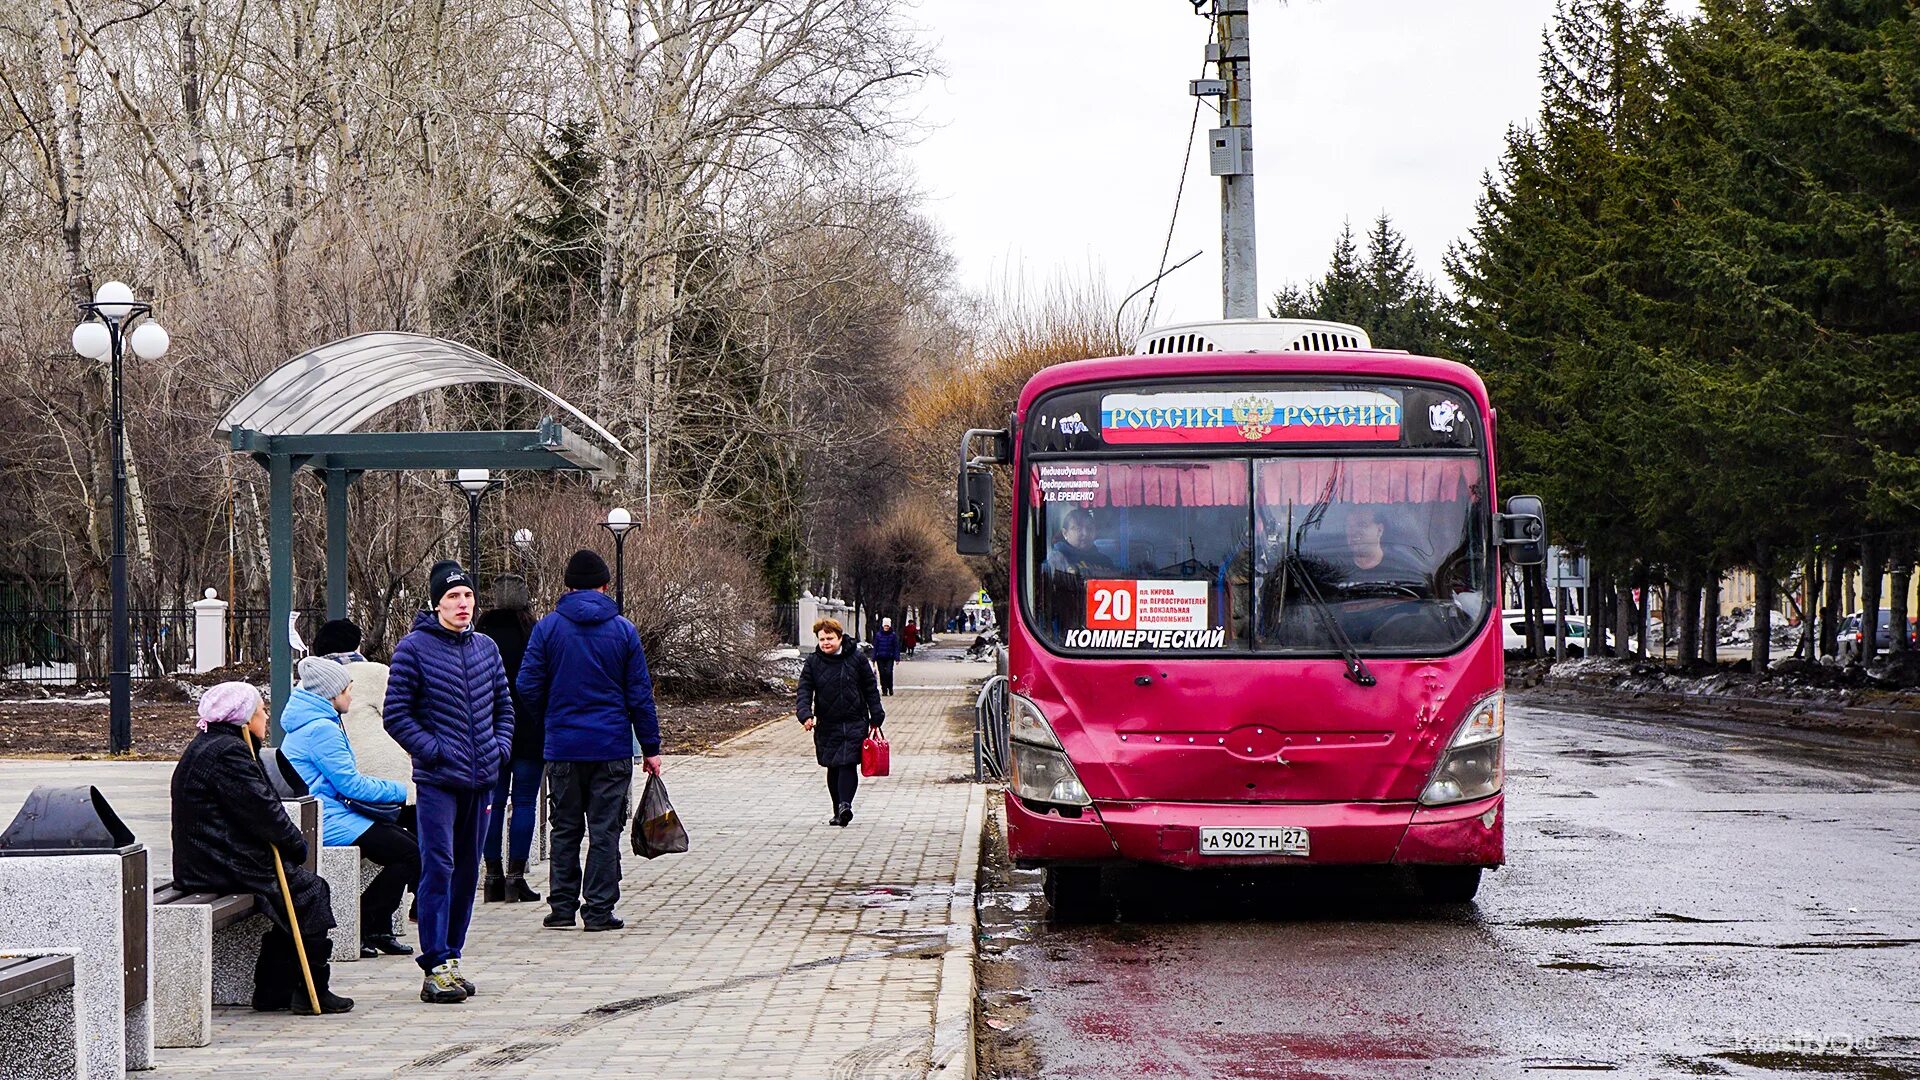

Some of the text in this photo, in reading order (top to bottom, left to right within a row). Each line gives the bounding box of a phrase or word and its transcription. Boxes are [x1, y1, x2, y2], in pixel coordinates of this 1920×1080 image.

[1109, 405, 1398, 429] РОССИЯ РОССИЯ
[1040, 466, 1098, 477] Индивидуальный
[1038, 479, 1100, 490] Предприниматель
[1043, 491, 1095, 502] А.В. ЕРЕМЕНКО
[1093, 589, 1132, 621] 20
[1150, 597, 1206, 605] ПЕРВОСТРОИТЕЛЕЙ
[1065, 626, 1226, 648] КОММЕРЧЕСКИЙ
[1284, 831, 1301, 844] 27
